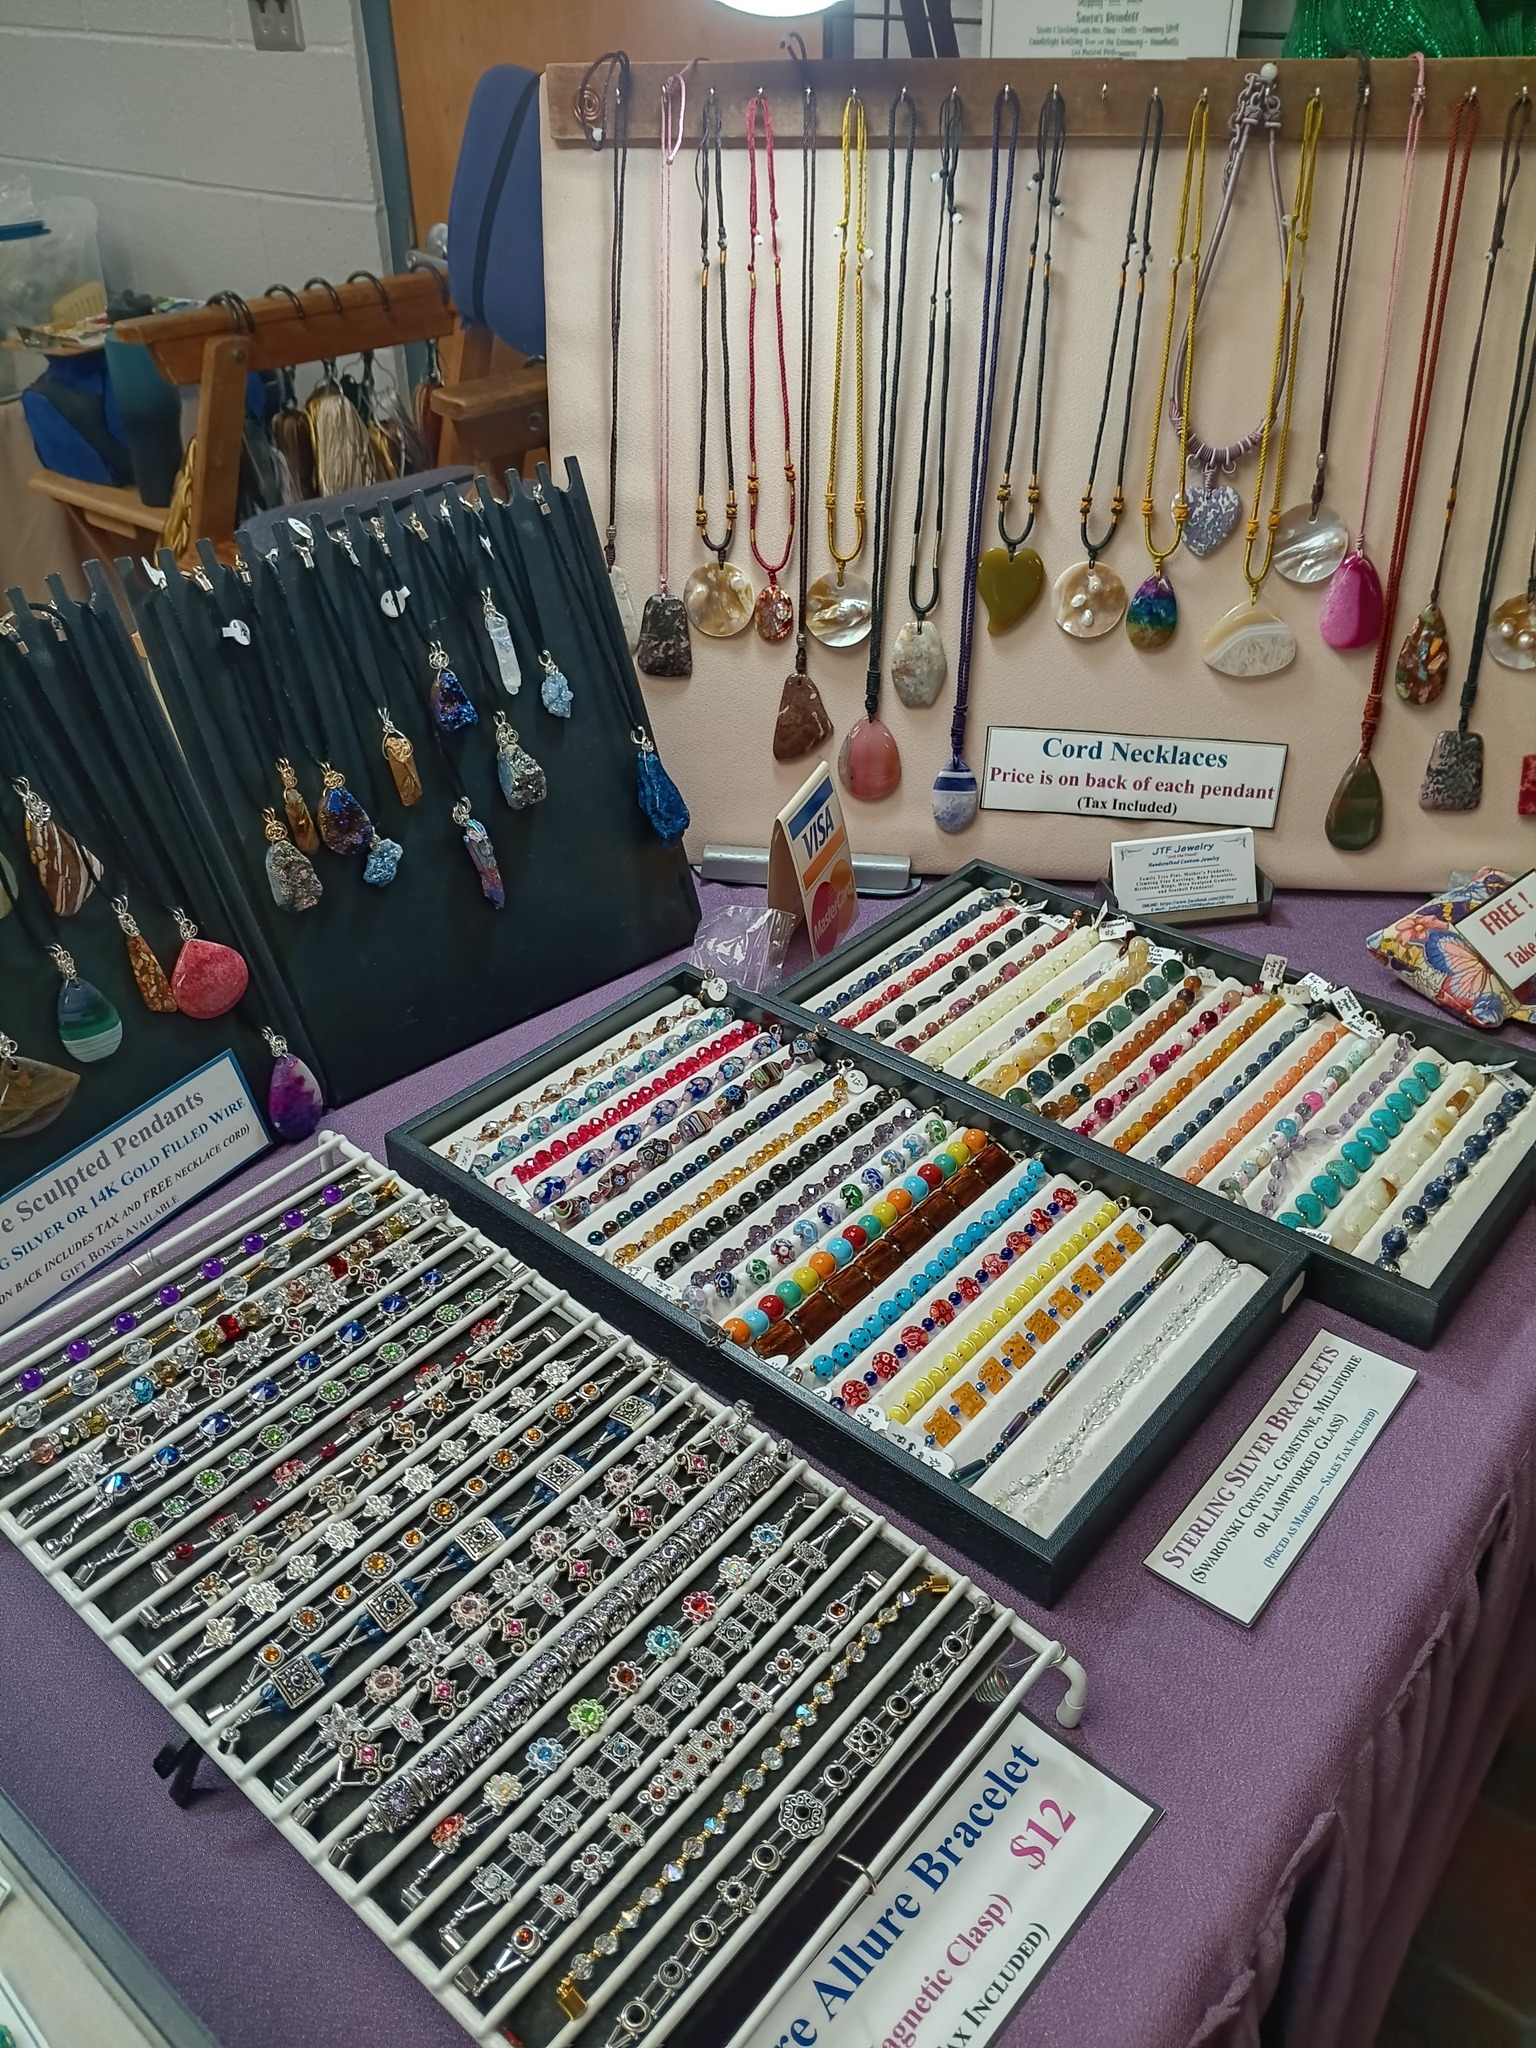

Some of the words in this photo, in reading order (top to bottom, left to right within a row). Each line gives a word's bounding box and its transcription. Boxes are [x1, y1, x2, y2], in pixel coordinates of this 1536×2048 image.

[1076, 10, 1104, 24] Santa's
[1106, 9, 1140, 23] Reindeer
[1043, 737, 1103, 761] Cord
[1110, 741, 1228, 769] Necklaces
[989, 766, 1034, 784] Price
[1039, 770, 1053, 785] is
[1058, 774, 1080, 787] on
[1085, 773, 1127, 791] back
[1132, 777, 1153, 792] of
[1155, 779, 1195, 795] each
[1200, 782, 1275, 801] pendant
[1077, 796, 1108, 811] (Tax
[1112, 798, 1178, 817] Included)
[802, 805, 835, 860] VISA
[1152, 846, 1172, 856] JTF
[1174, 843, 1214, 854] Jewelry
[1148, 860, 1180, 868] Handcrafted
[1201, 855, 1220, 863] Jewelry
[814, 875, 853, 943] MasterCard
[1479, 898, 1525, 936] FREE
[1504, 942, 1536, 969] Take
[16, 1155, 111, 1224] Sculpted
[111, 1091, 205, 1159] Pendants
[11, 1220, 66, 1261] SILVER
[66, 1205, 89, 1225] OR
[89, 1181, 121, 1209] 14K
[120, 1155, 161, 1187] GOLD
[161, 1122, 209, 1161] FILLED
[208, 1097, 246, 1126] WIRE
[15, 1269, 43, 1294] BACK
[44, 1232, 95, 1275] INCLUDES
[95, 1212, 121, 1237] TAX
[121, 1199, 142, 1220] AND
[142, 1175, 174, 1204] FREE
[174, 1144, 222, 1181] NECKLACE
[222, 1123, 251, 1149] CORD)
[59, 1259, 88, 1283] GIFT
[88, 1234, 125, 1264] BOXES
[125, 1194, 180, 1238] AVAILABLE
[1346, 1408, 1380, 1448] INCLUDED)
[1162, 1487, 1236, 1570] STERLING
[1224, 1431, 1279, 1489] SILVER
[1265, 1345, 1340, 1434] BRACELETS
[1189, 1518, 1246, 1585] (SWAROVSKI
[1238, 1472, 1283, 1520] CRYSTAL,
[1273, 1416, 1324, 1472] GEMSTONE,
[1312, 1354, 1363, 1415] MILLIFIORIE
[1337, 1444, 1353, 1464] TAX
[1253, 1521, 1271, 1539] OR
[1262, 1450, 1322, 1526] LAMPWORKED
[1314, 1413, 1349, 1452] GLASS)
[1320, 1462, 1341, 1487] SALES
[1291, 1494, 1320, 1528] MARKED
[1263, 1535, 1291, 1569] (PRICED
[1286, 1526, 1298, 1538] AS
[1009, 1797, 1077, 1872] $12
[810, 1891, 922, 2023] Allure
[904, 1741, 1041, 1896] Bracelet
[872, 1968, 953, 2048] agnetic
[946, 1892, 1015, 1968] Clasp)
[962, 1921, 1051, 2030] INCLUDED)
